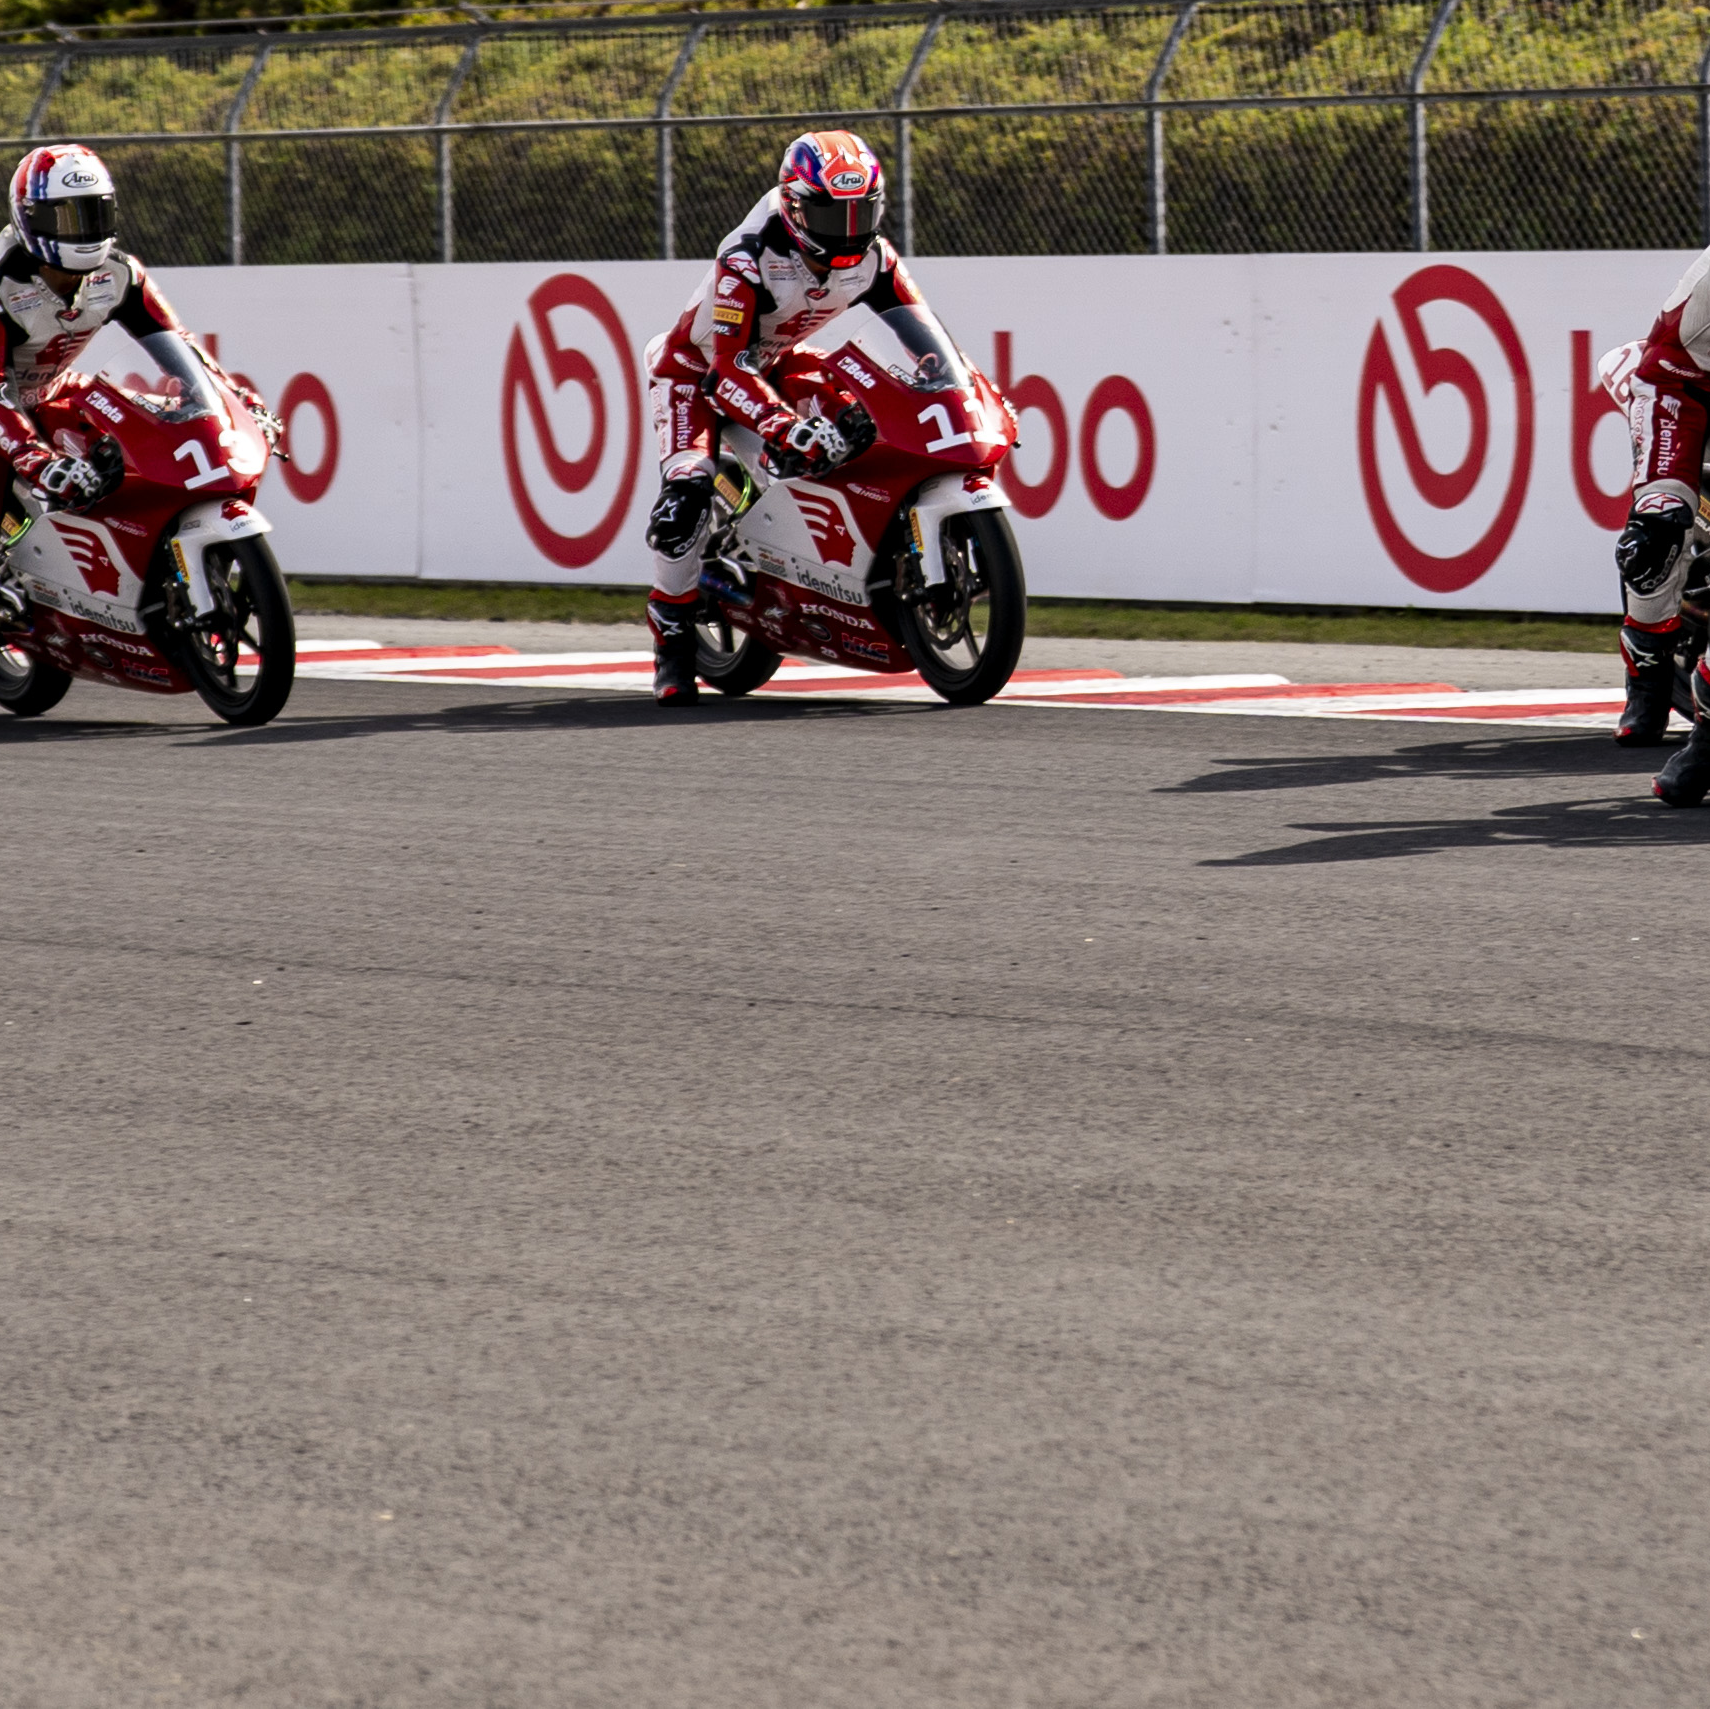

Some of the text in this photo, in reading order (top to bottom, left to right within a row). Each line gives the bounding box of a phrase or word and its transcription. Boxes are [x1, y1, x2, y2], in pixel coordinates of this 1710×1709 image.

[847, 362, 877, 389] Beta
[98, 396, 124, 424] Beta
[729, 387, 764, 420] Bet
[917, 397, 1008, 454] 11
[795, 565, 863, 605] idemitsu
[68, 595, 137, 634] idemitsu
[799, 602, 875, 631] HONDA
[79, 633, 155, 657] HONDA
